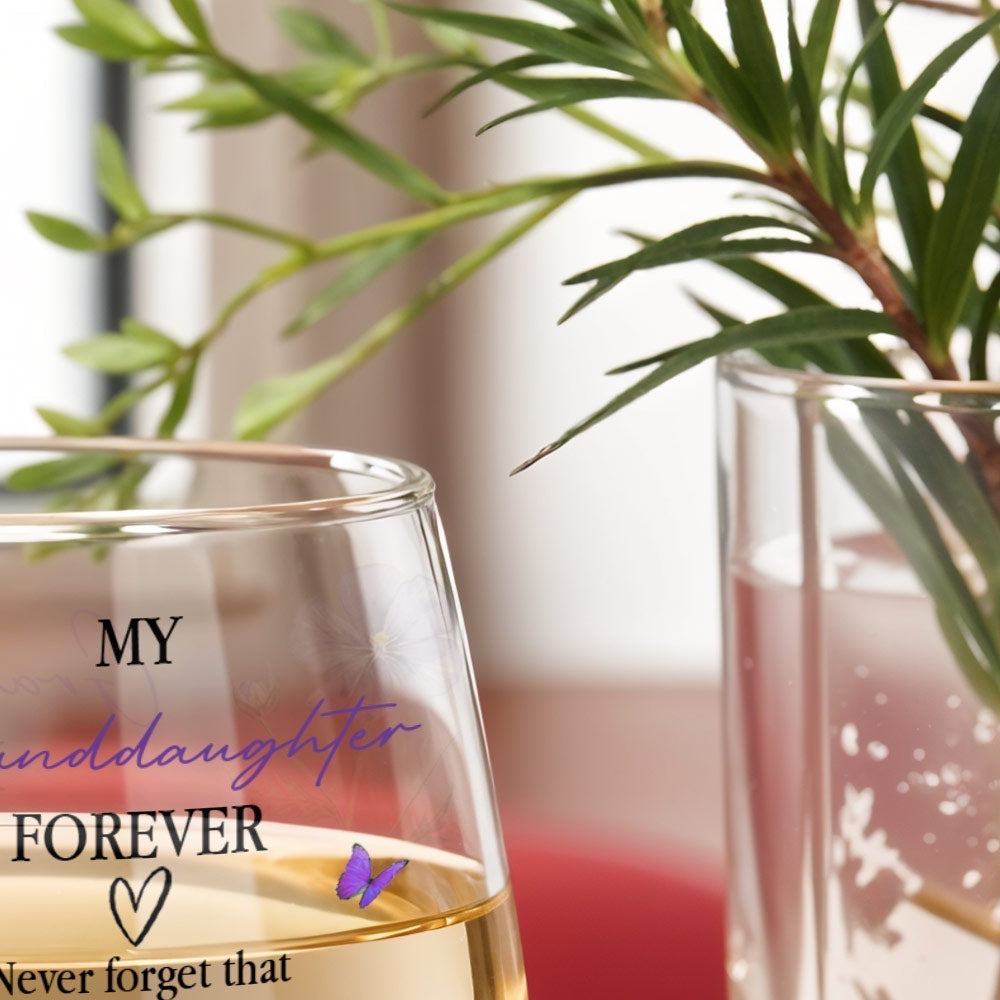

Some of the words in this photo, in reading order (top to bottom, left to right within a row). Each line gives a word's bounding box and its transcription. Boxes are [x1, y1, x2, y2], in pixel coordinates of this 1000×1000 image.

[95, 615, 184, 668] MY
[11, 803, 267, 862] FOREVER
[222, 949, 292, 987] that
